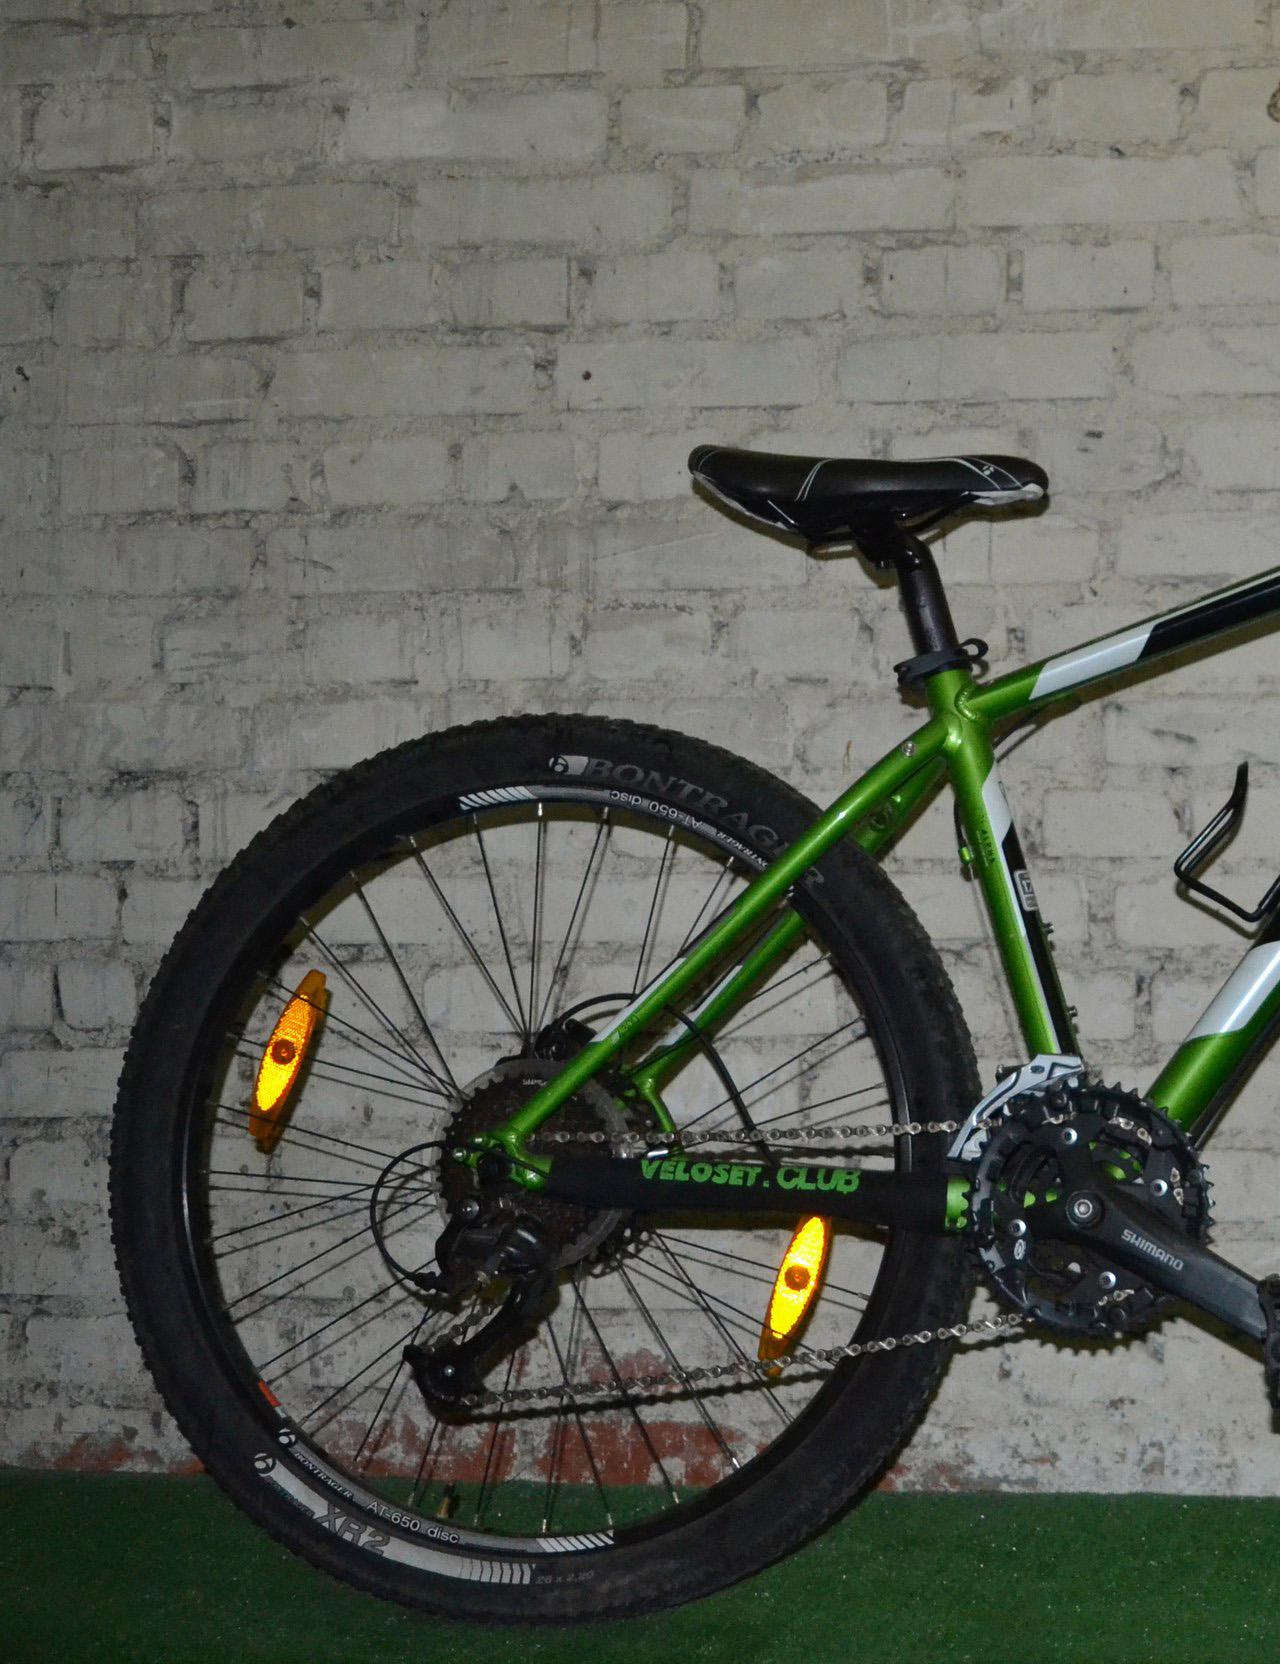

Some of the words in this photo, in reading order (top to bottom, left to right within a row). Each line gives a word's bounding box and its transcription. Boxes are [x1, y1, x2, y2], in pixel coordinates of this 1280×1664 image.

[609, 789, 643, 807] disc
[648, 799, 703, 829] AT-650
[584, 760, 825, 888] BONTRAGR
[775, 1165, 863, 1195] CLUB
[1120, 1228, 1185, 1273] SHIMANO
[293, 1451, 354, 1500] BONTRAGER
[366, 1499, 422, 1532] AT-650
[427, 1526, 460, 1545] disc
[315, 1502, 392, 1556] XR2
